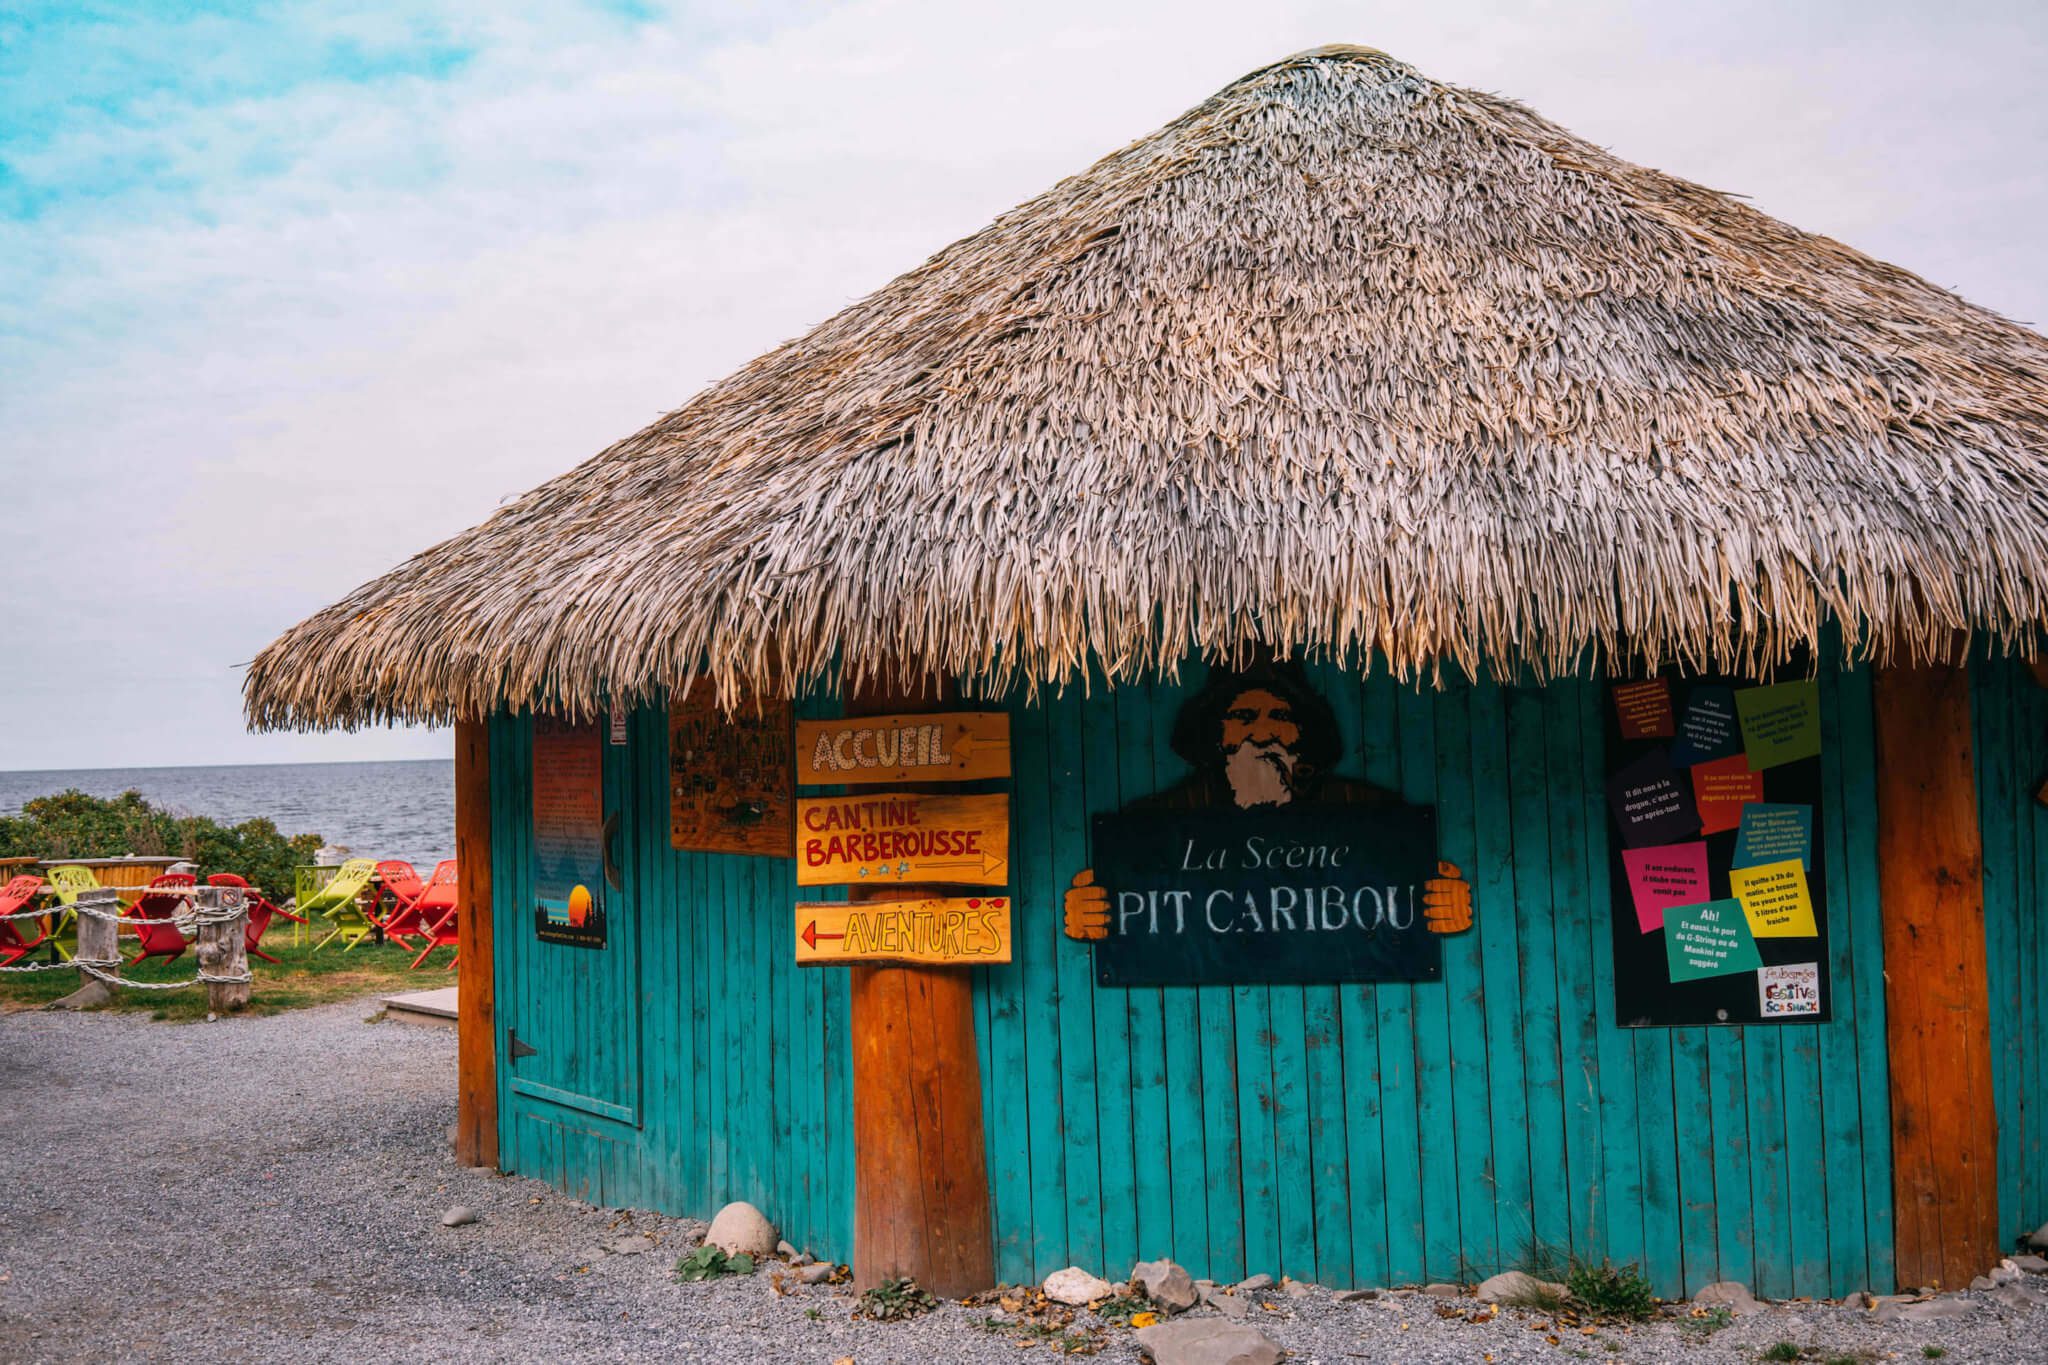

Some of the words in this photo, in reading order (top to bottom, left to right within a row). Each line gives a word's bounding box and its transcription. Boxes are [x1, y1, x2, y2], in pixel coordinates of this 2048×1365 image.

[812, 723, 951, 772] ACCUEIL
[804, 801, 921, 833] CANTINE
[806, 830, 983, 868] BARBEROUSSE
[1182, 838, 1227, 871] La
[1241, 836, 1350, 870] Scène
[1117, 889, 1192, 936] PIT
[1204, 885, 1415, 934] CARIBOU
[1680, 920, 1689, 929] Et
[1700, 908, 1720, 922] Ah!
[843, 911, 1001, 956] AVENTURES
